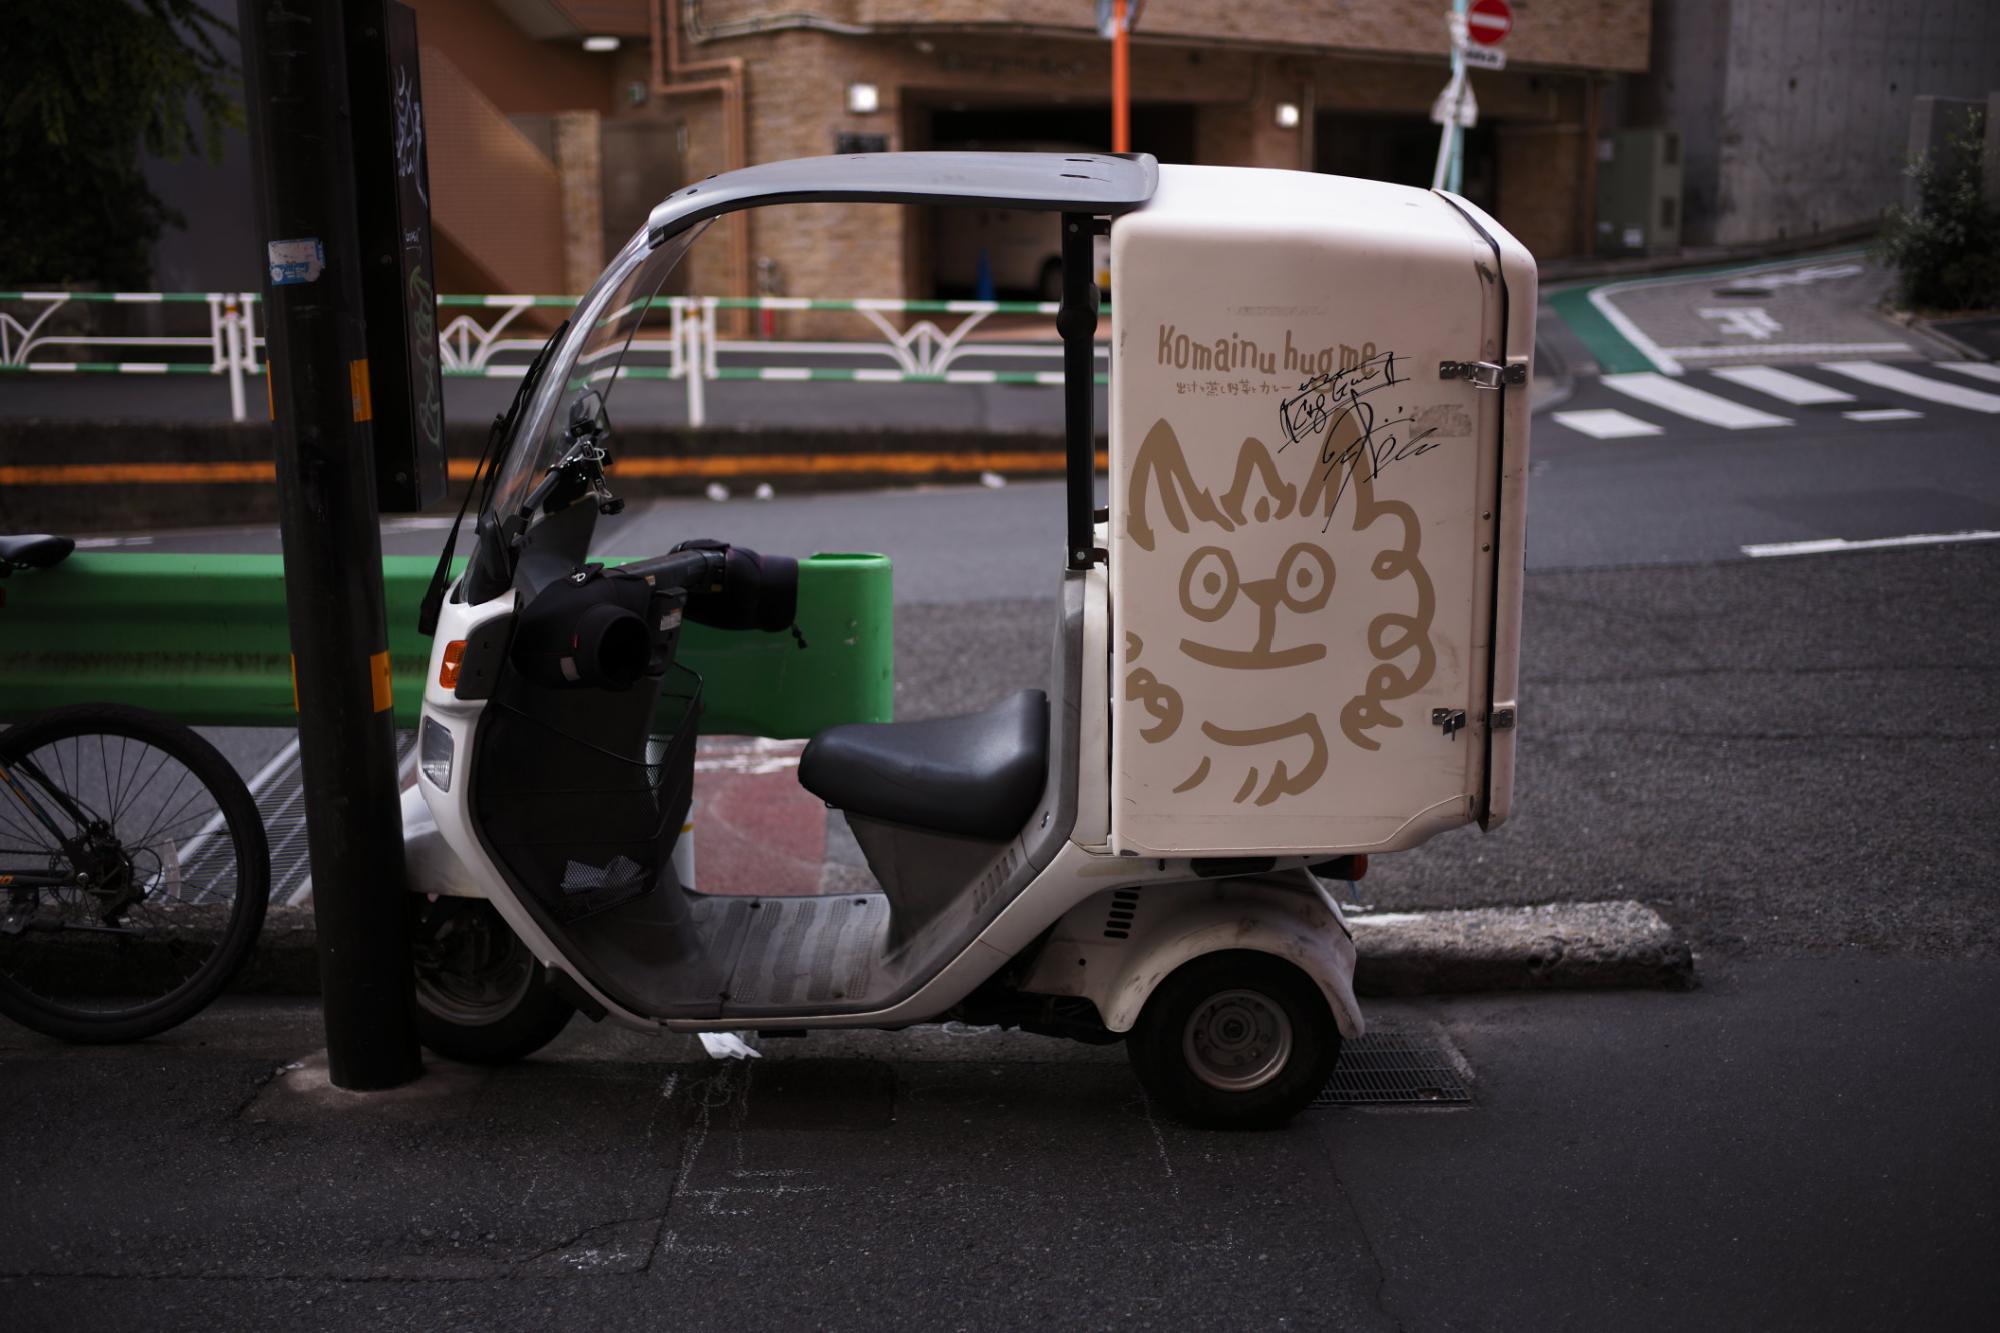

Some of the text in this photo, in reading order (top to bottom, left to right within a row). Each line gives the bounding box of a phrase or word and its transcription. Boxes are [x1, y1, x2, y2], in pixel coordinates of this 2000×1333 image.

[1157, 324, 1377, 394] Komainu hug me
